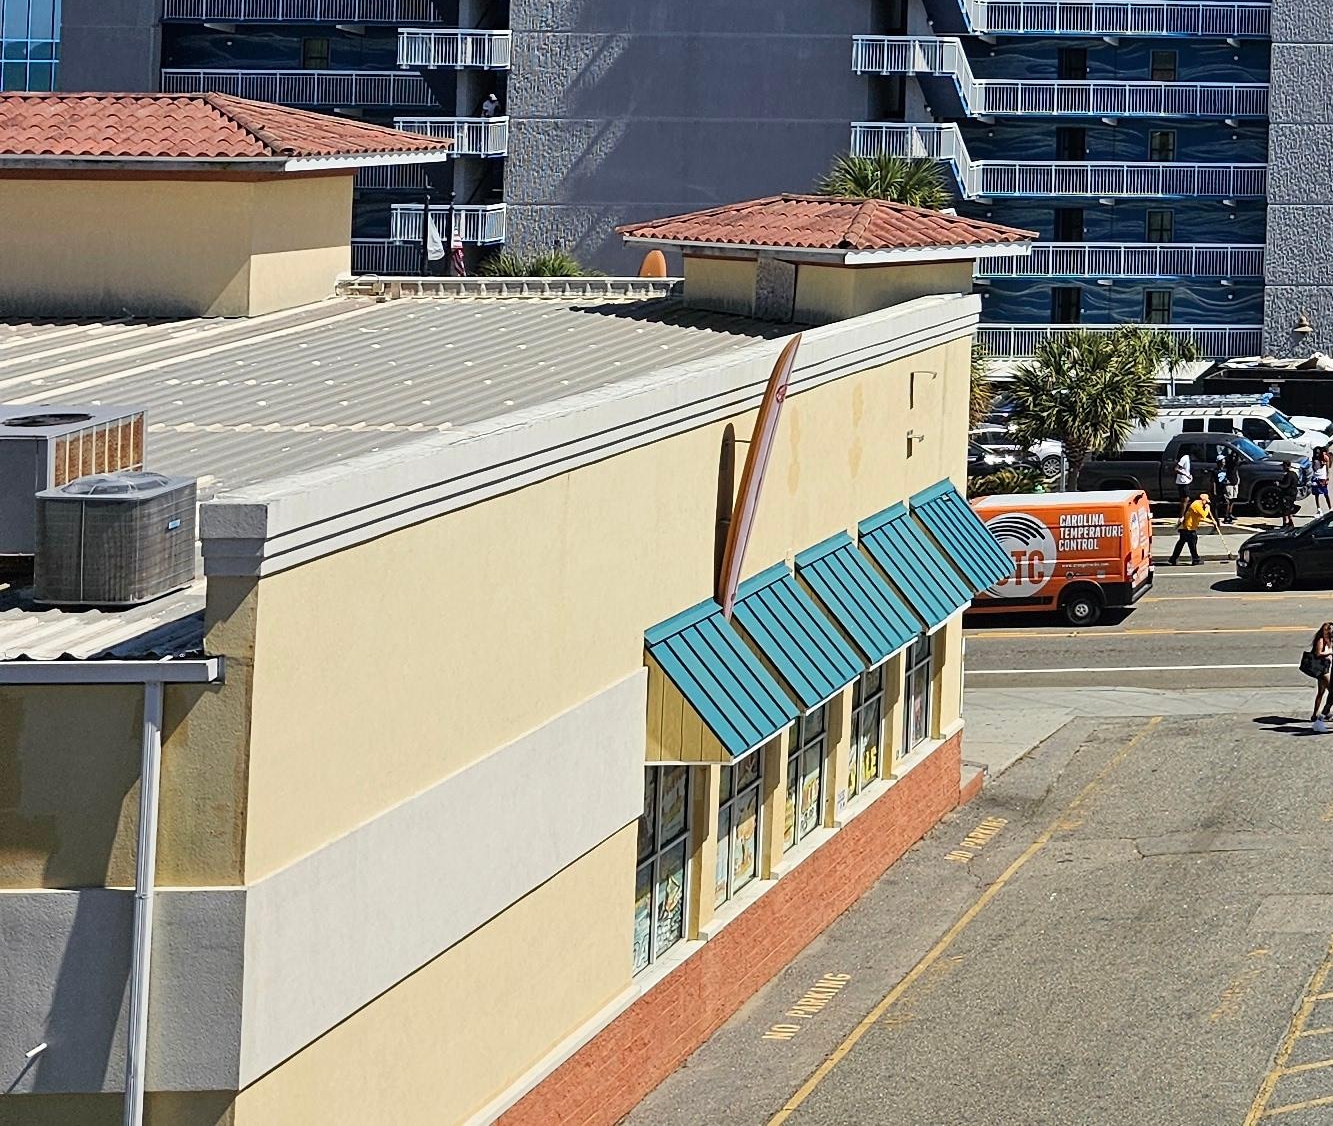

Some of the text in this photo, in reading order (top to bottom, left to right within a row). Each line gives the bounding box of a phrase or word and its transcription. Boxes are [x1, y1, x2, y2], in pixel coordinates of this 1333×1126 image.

[1059, 513, 1104, 527] CAROLINA
[1059, 525, 1124, 539] TEMPERATURE
[1058, 538, 1099, 551] CONTROL
[996, 549, 1045, 586] TC
[761, 1024, 801, 1041] NO
[785, 972, 852, 1019] PARKING
